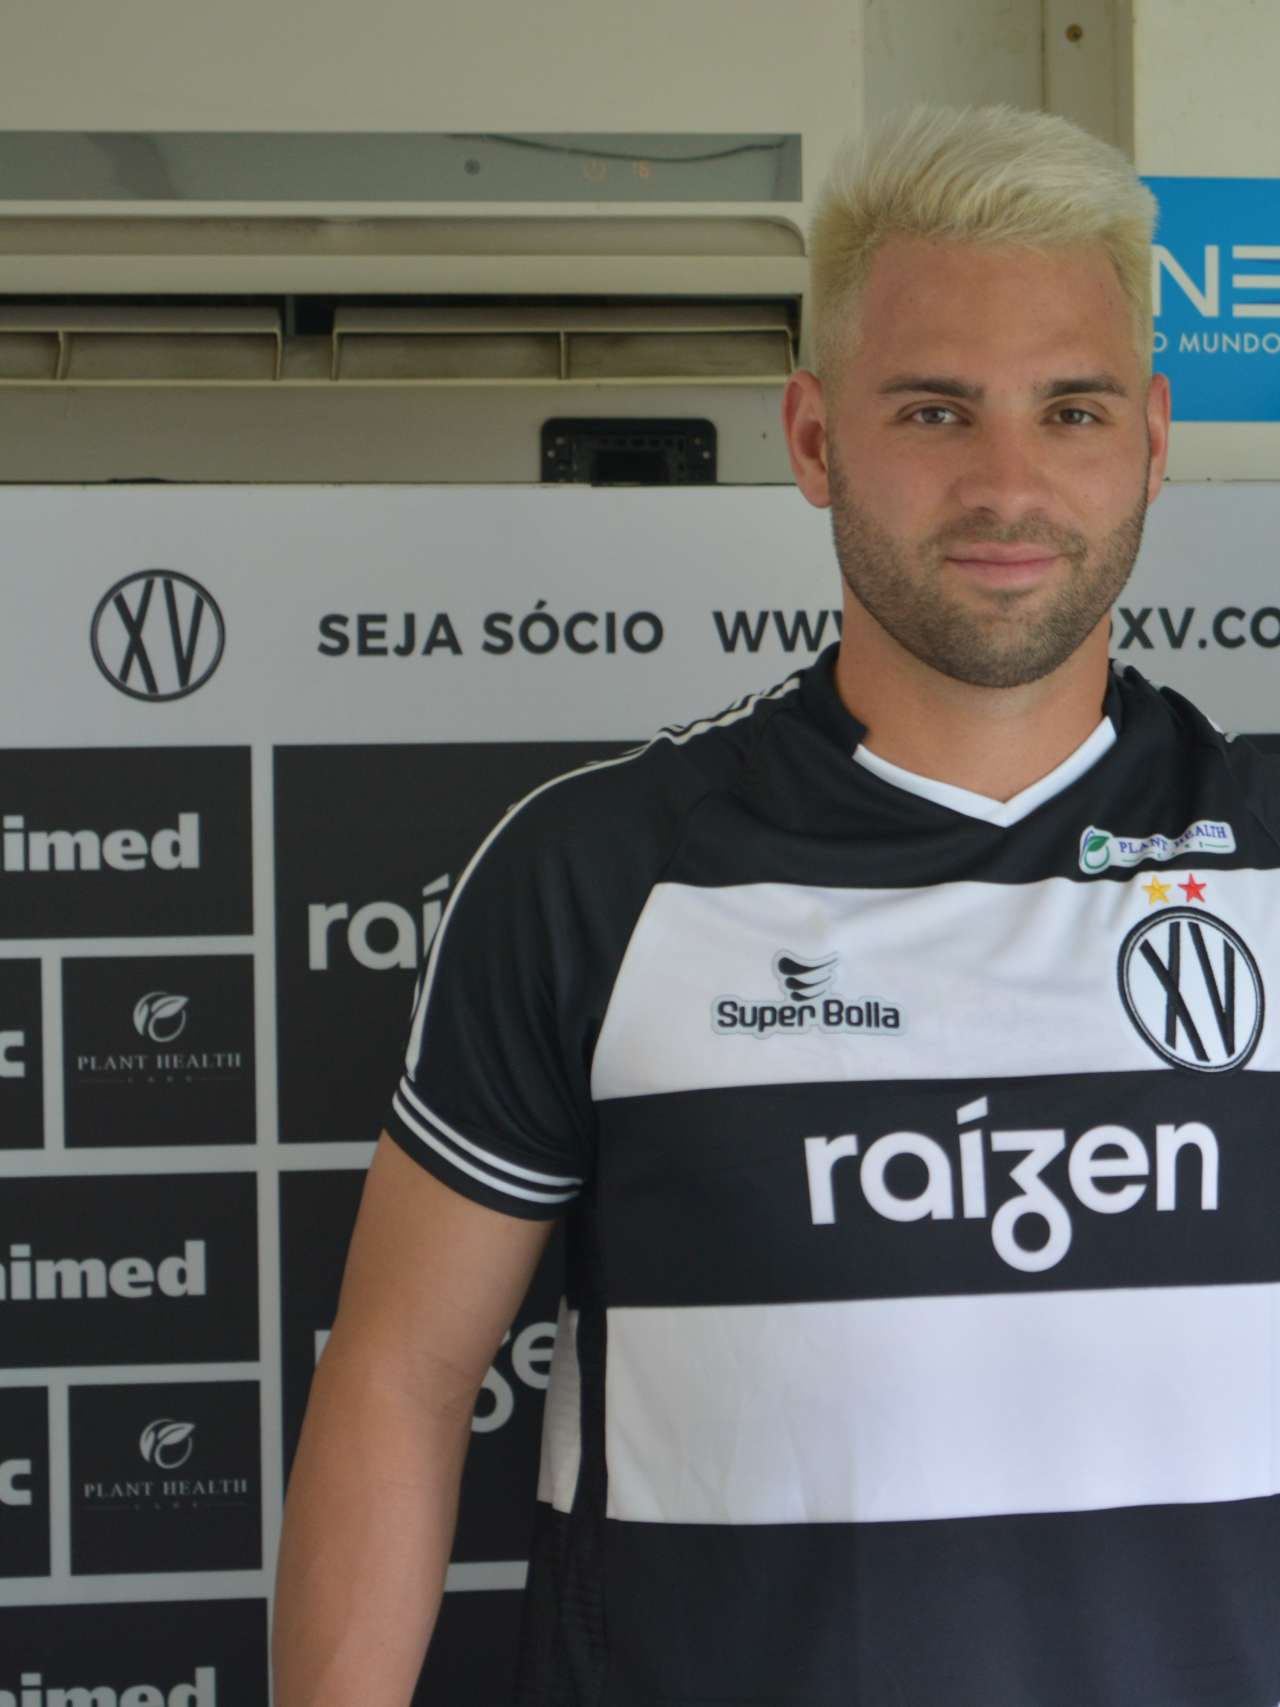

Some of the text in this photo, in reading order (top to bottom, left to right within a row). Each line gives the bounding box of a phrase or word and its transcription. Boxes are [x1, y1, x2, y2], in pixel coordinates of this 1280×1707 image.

[112, 577, 205, 695] XV
[317, 612, 463, 656] SEJA
[481, 600, 664, 656] SÓCIO
[711, 610, 843, 654] WW
[1118, 836, 1169, 854] PLANT
[308, 872, 449, 971] raí
[717, 999, 901, 1033] Super Bolla
[1139, 920, 1237, 1063] XV
[77, 1052, 242, 1071] PLANT HEALTH
[0, 1239, 206, 1300] imed
[83, 1478, 248, 1499] PLANT HEALTH
